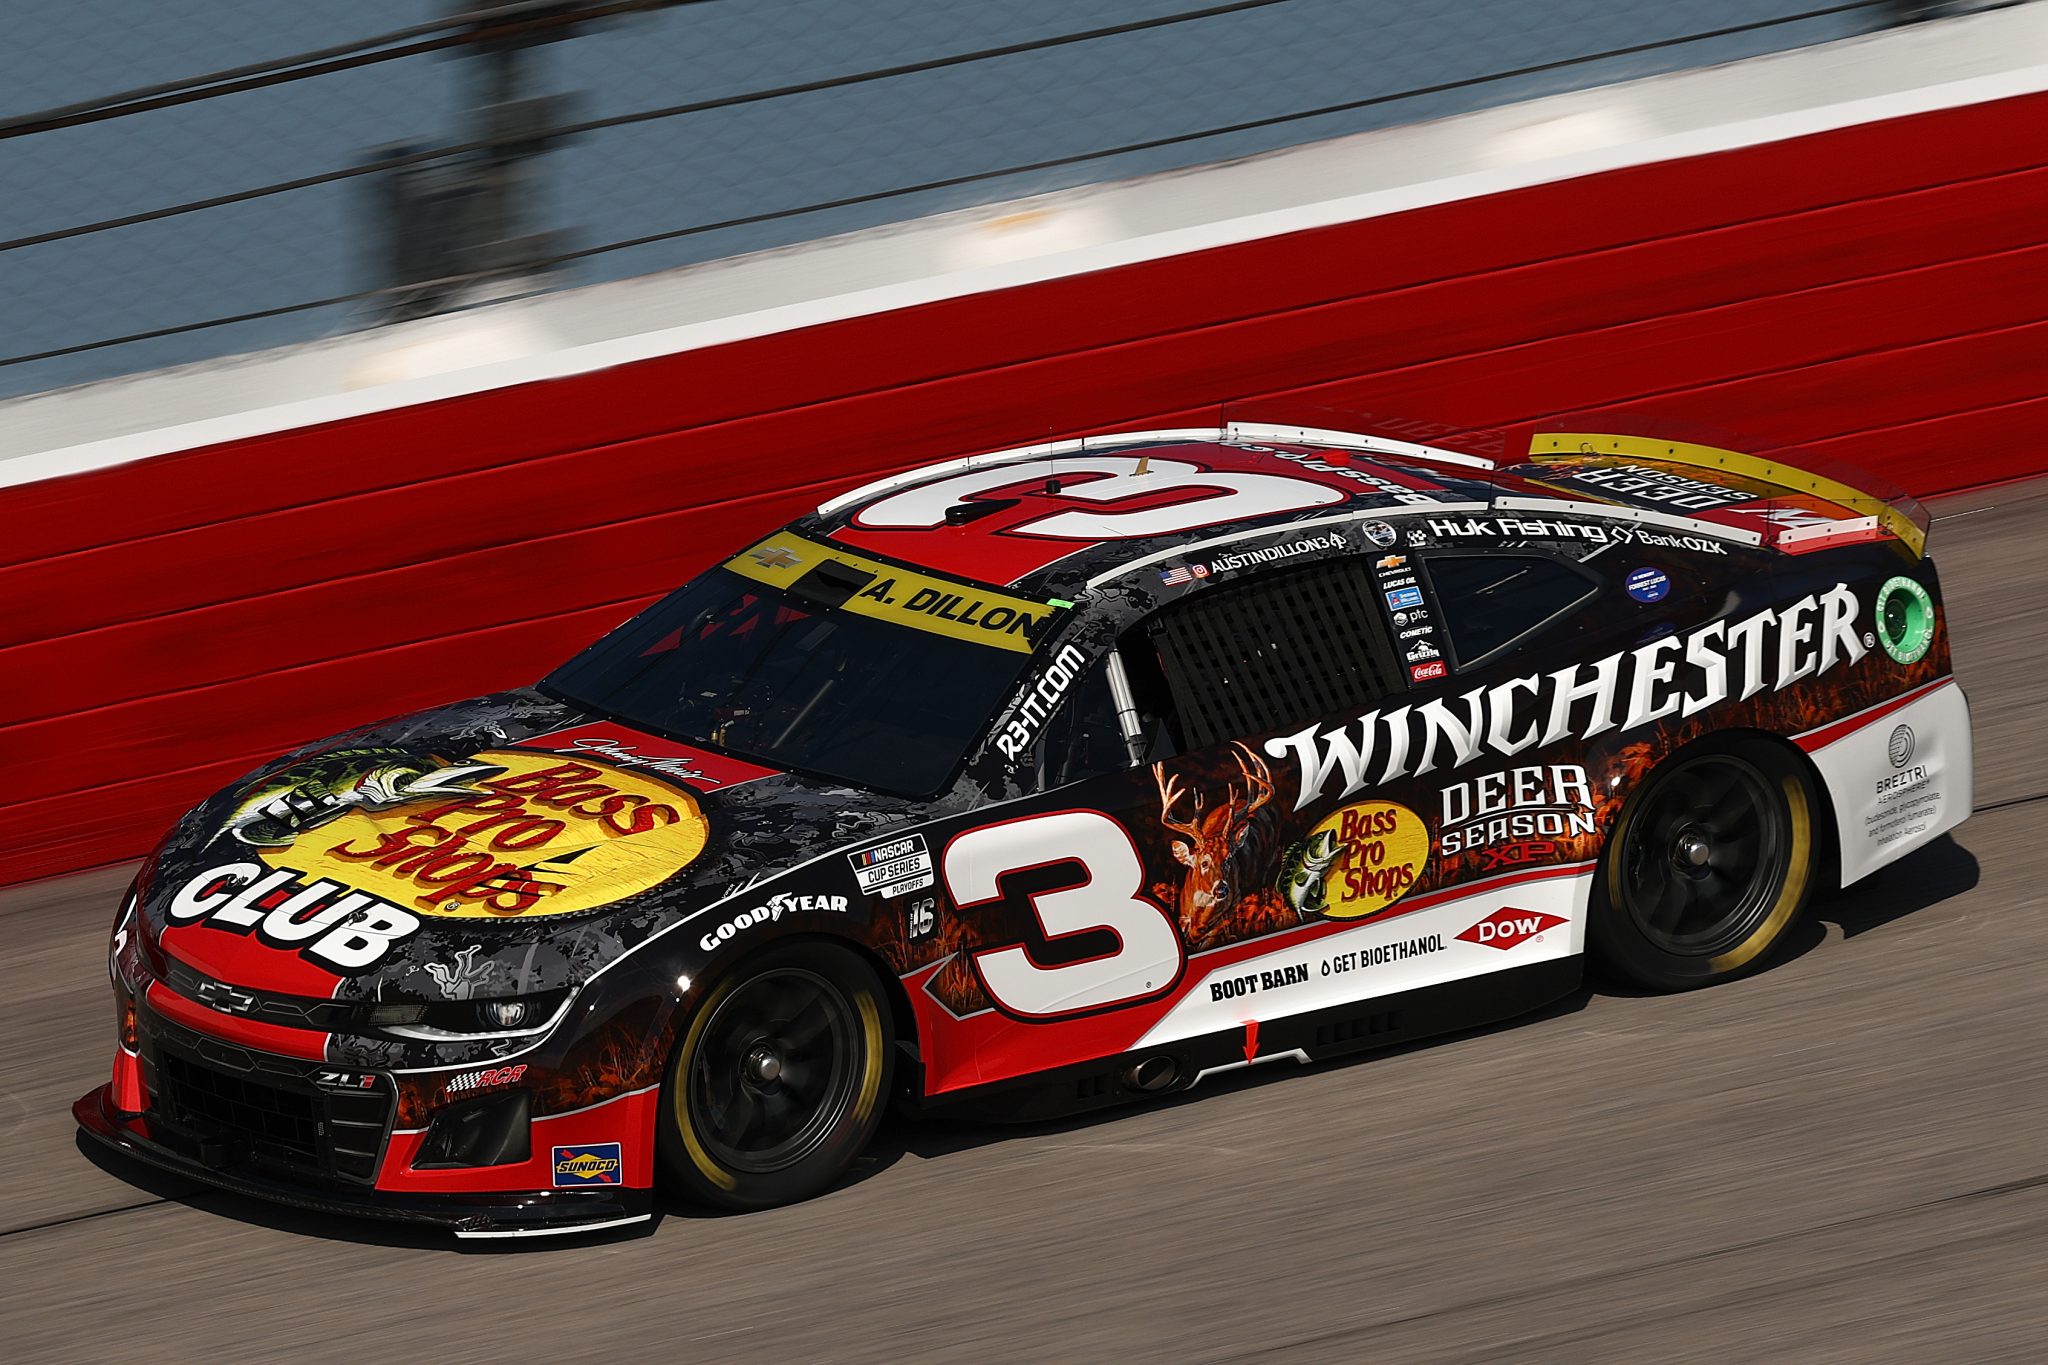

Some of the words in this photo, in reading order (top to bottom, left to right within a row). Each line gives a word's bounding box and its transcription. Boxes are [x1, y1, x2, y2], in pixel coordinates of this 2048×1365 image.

[852, 456, 1346, 540] 3
[1572, 467, 1734, 510] DEER
[1614, 464, 1759, 500] SEASON
[1427, 518, 1497, 537] Huk
[1500, 518, 1608, 543] Fishing
[1383, 578, 1405, 590] LUCAS
[1405, 576, 1417, 585] OIL
[859, 578, 897, 606] A.
[901, 587, 1047, 639] DILLON
[1409, 608, 1429, 623] ptc
[1399, 626, 1433, 639] COMETIC
[1406, 648, 1441, 662] Grizzly
[996, 644, 1086, 762] R3-IT.COM
[1264, 583, 1868, 812] WINCHESTER
[1440, 764, 1596, 829] DEER
[1876, 764, 1928, 794] BREZTRI
[477, 761, 681, 836] Bass
[405, 788, 568, 852] Pro
[1338, 807, 1397, 843] Bass
[1441, 812, 1596, 856] SEASON
[873, 839, 915, 861] NASCAR
[1340, 839, 1386, 871] Pro
[1482, 841, 1556, 871] XP
[324, 824, 568, 916] Shops
[868, 867, 887, 884] CUP
[887, 858, 921, 880] SERIES
[892, 877, 924, 896] PLAYOFFS
[1341, 862, 1415, 903] Shops
[168, 861, 421, 969] CLUB
[700, 891, 849, 952] GOODYEAR
[911, 897, 935, 938] 16
[943, 809, 1187, 1018] 3
[1478, 915, 1544, 943] DOW
[1333, 953, 1358, 974] GET
[1361, 933, 1445, 968] BIOETHANOL
[1209, 974, 1259, 1002] BOOT
[1260, 962, 1309, 991] BARN
[317, 1071, 376, 1089] ZL1
[476, 1064, 528, 1088] RCR
[557, 1158, 617, 1174] SUNOCO
